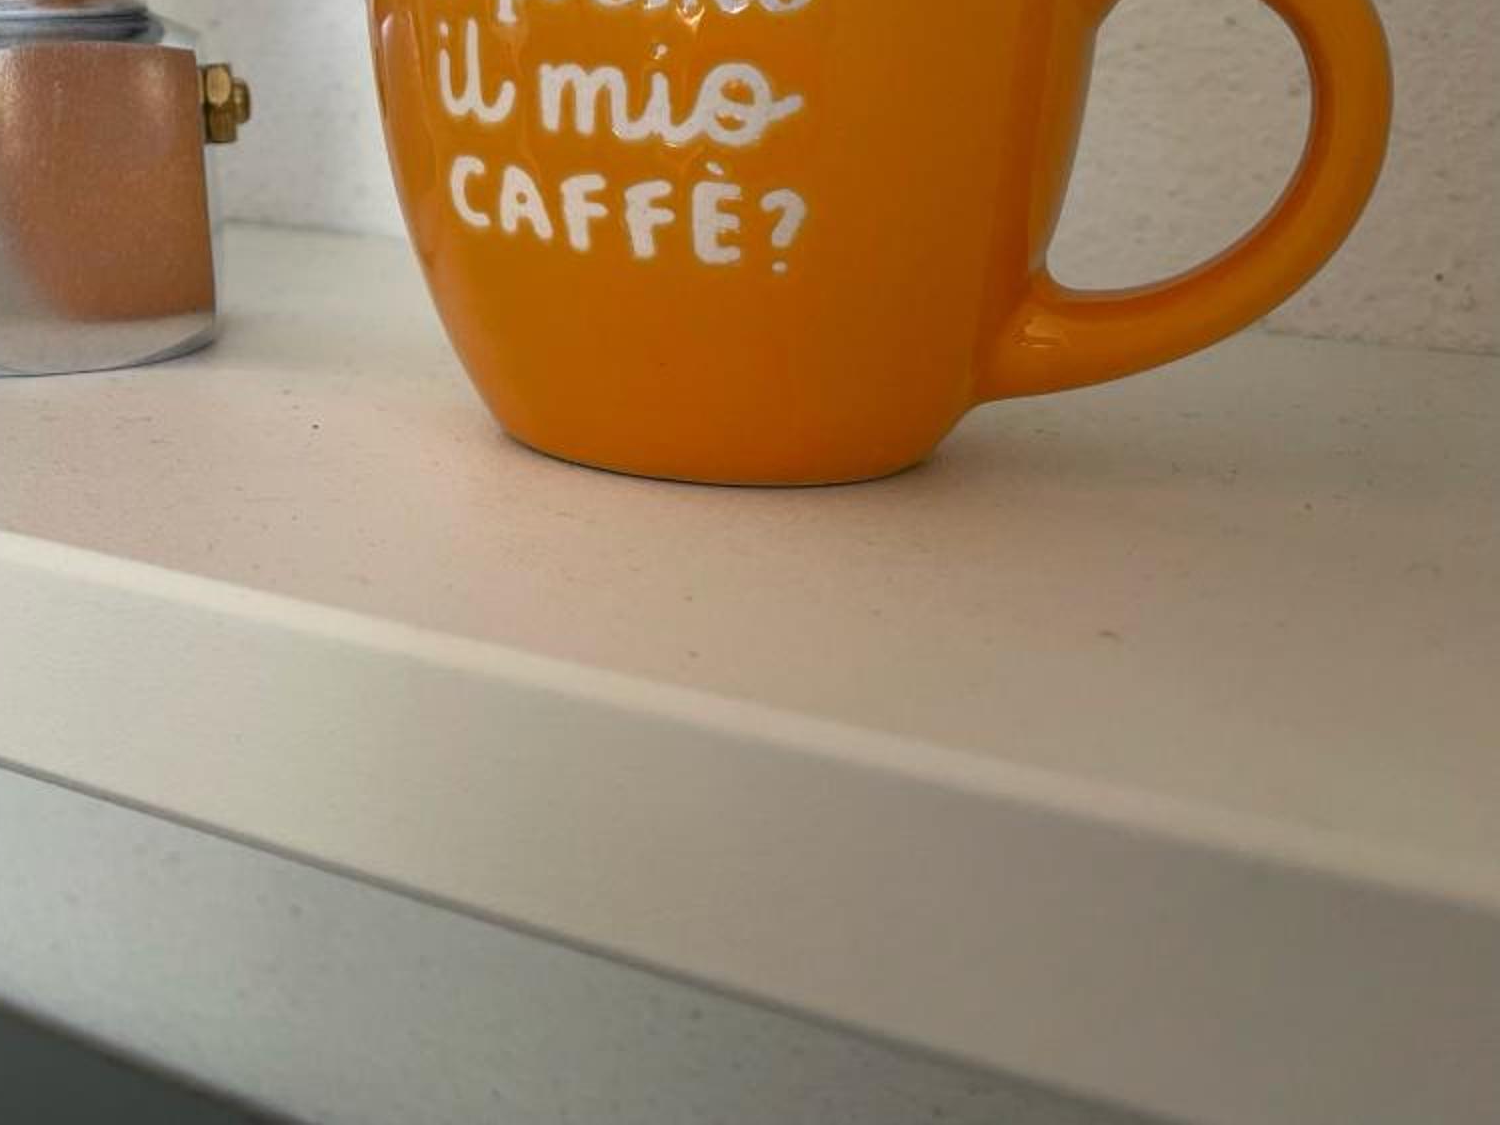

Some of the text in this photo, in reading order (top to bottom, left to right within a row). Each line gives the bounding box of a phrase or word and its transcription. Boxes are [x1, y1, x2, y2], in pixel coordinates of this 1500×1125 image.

[439, 18, 803, 146] il mio
[449, 155, 807, 273] CAFFÈ?
